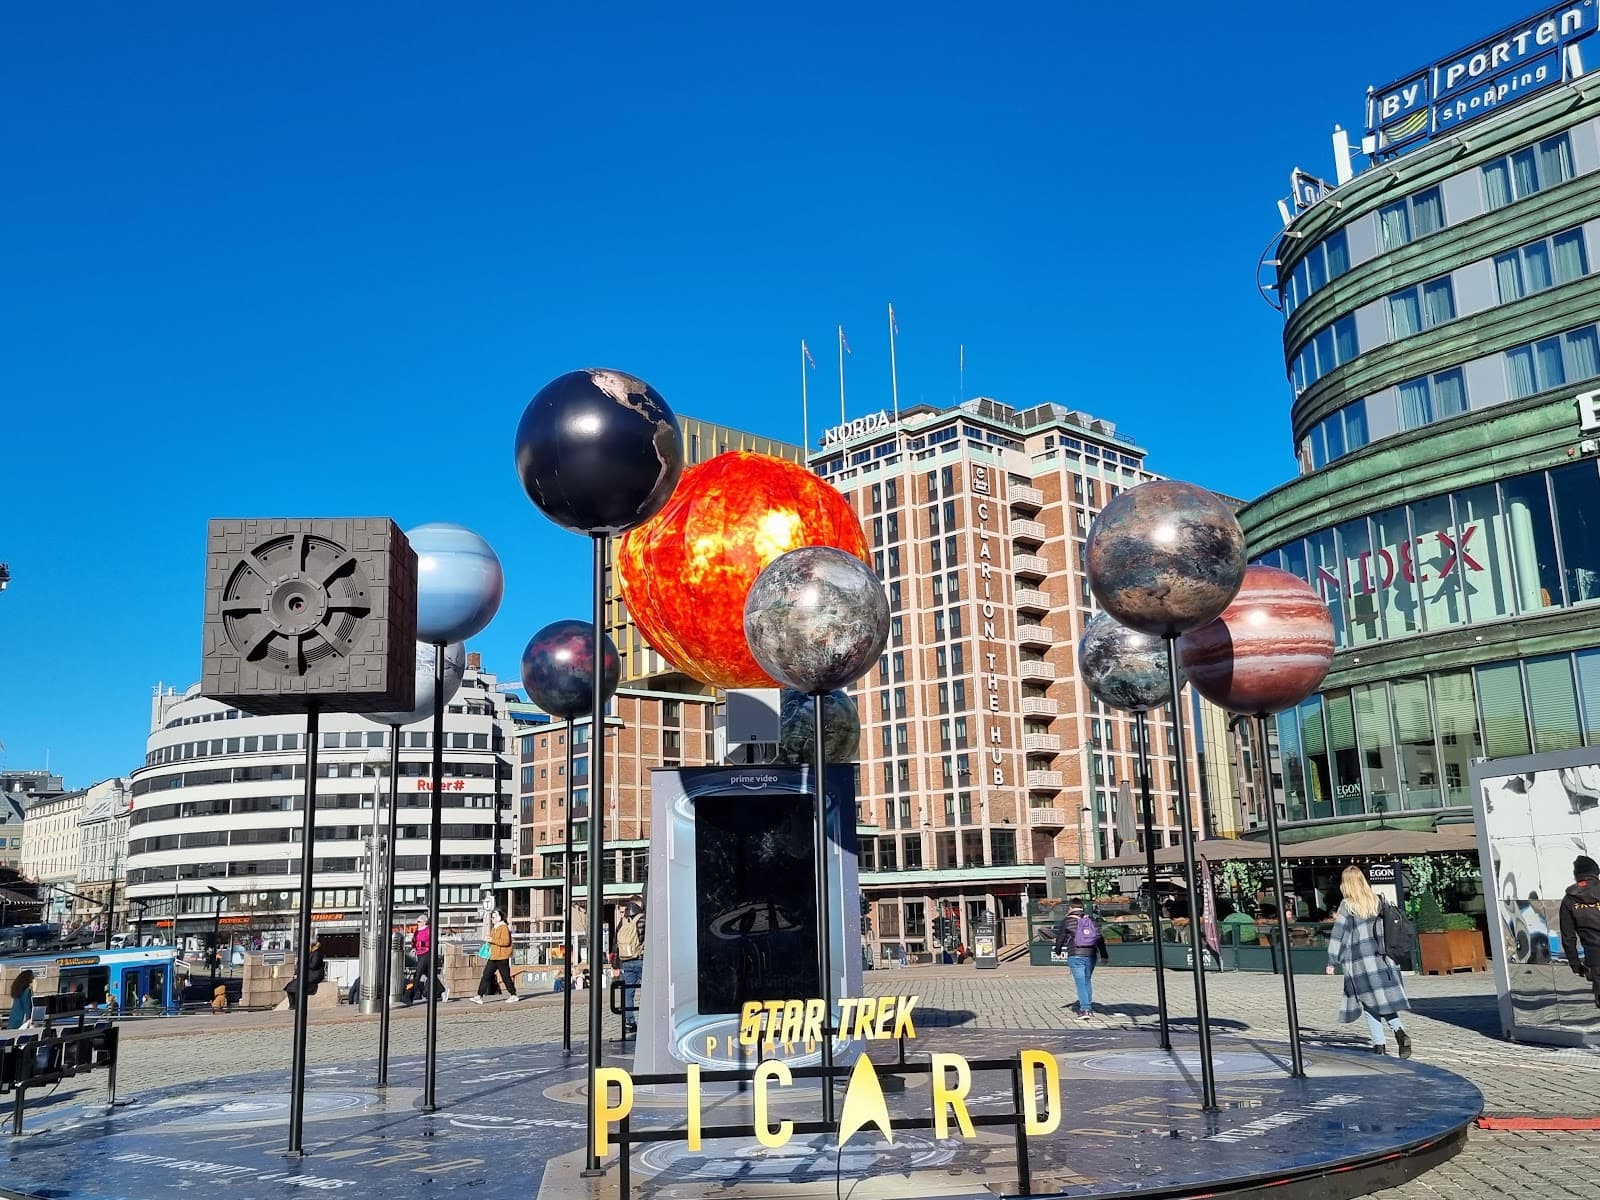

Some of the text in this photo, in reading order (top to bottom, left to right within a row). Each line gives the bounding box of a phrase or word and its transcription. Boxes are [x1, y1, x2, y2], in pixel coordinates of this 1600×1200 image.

[1443, 65, 1547, 120] shopping
[825, 409, 890, 447] NORDA
[977, 503, 995, 639] CLARION
[986, 653, 999, 712] THE
[730, 774, 778, 784] prime video
[990, 726, 1004, 785] HUB
[417, 779, 465, 791] Ruer#
[1336, 784, 1361, 795] EGON
[1369, 869, 1394, 877] EGON
[740, 995, 920, 1046] STAR TREK
[594, 1049, 1062, 1158] PICARD
